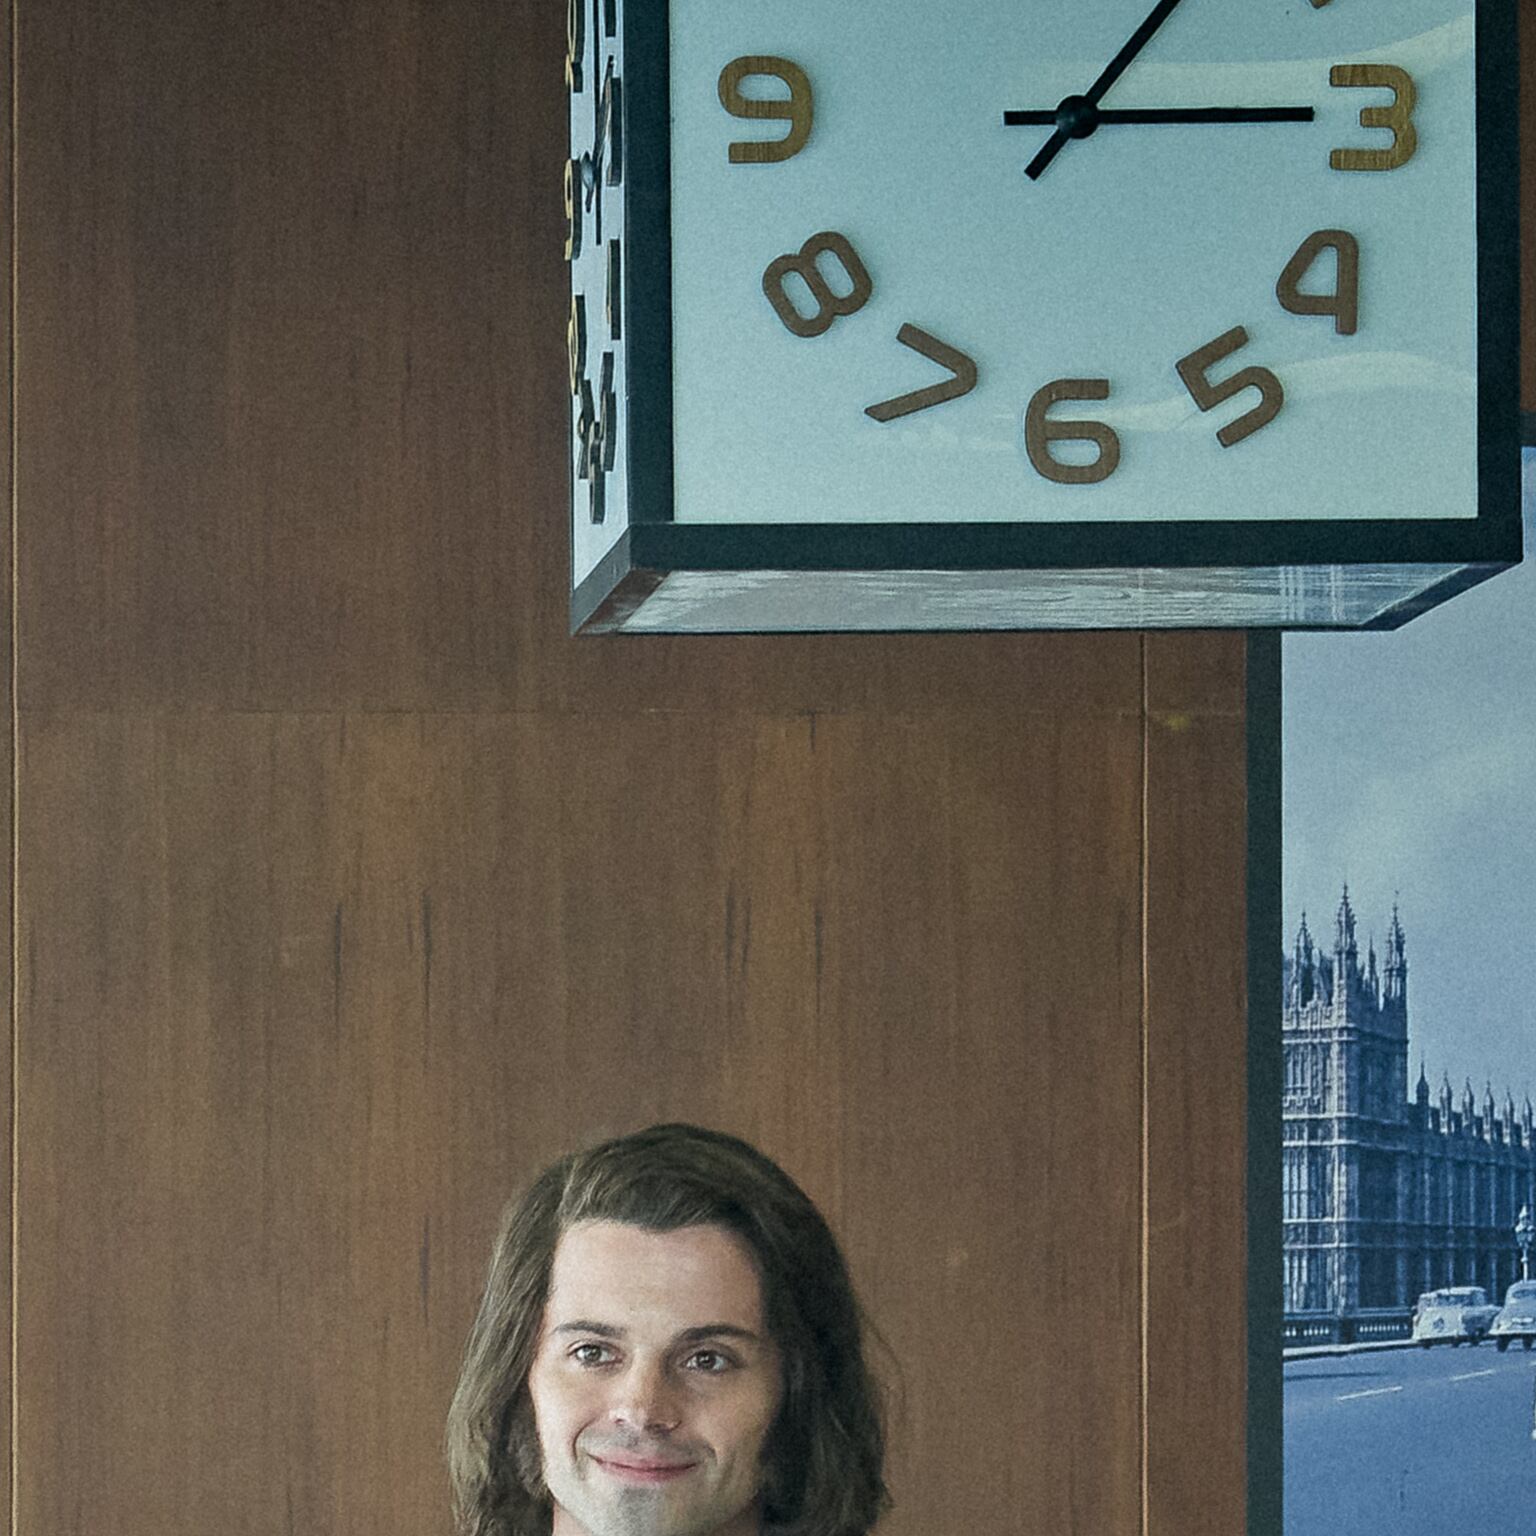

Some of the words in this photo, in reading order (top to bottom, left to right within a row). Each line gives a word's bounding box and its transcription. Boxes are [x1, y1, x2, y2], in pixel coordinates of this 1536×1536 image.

[717, 54, 814, 164] 9
[1328, 63, 1419, 172] 3
[761, 230, 875, 339] 8
[1275, 228, 1360, 336] 4
[863, 322, 980, 424] 7
[1174, 325, 1285, 449] 5
[1024, 377, 1121, 486] 6
